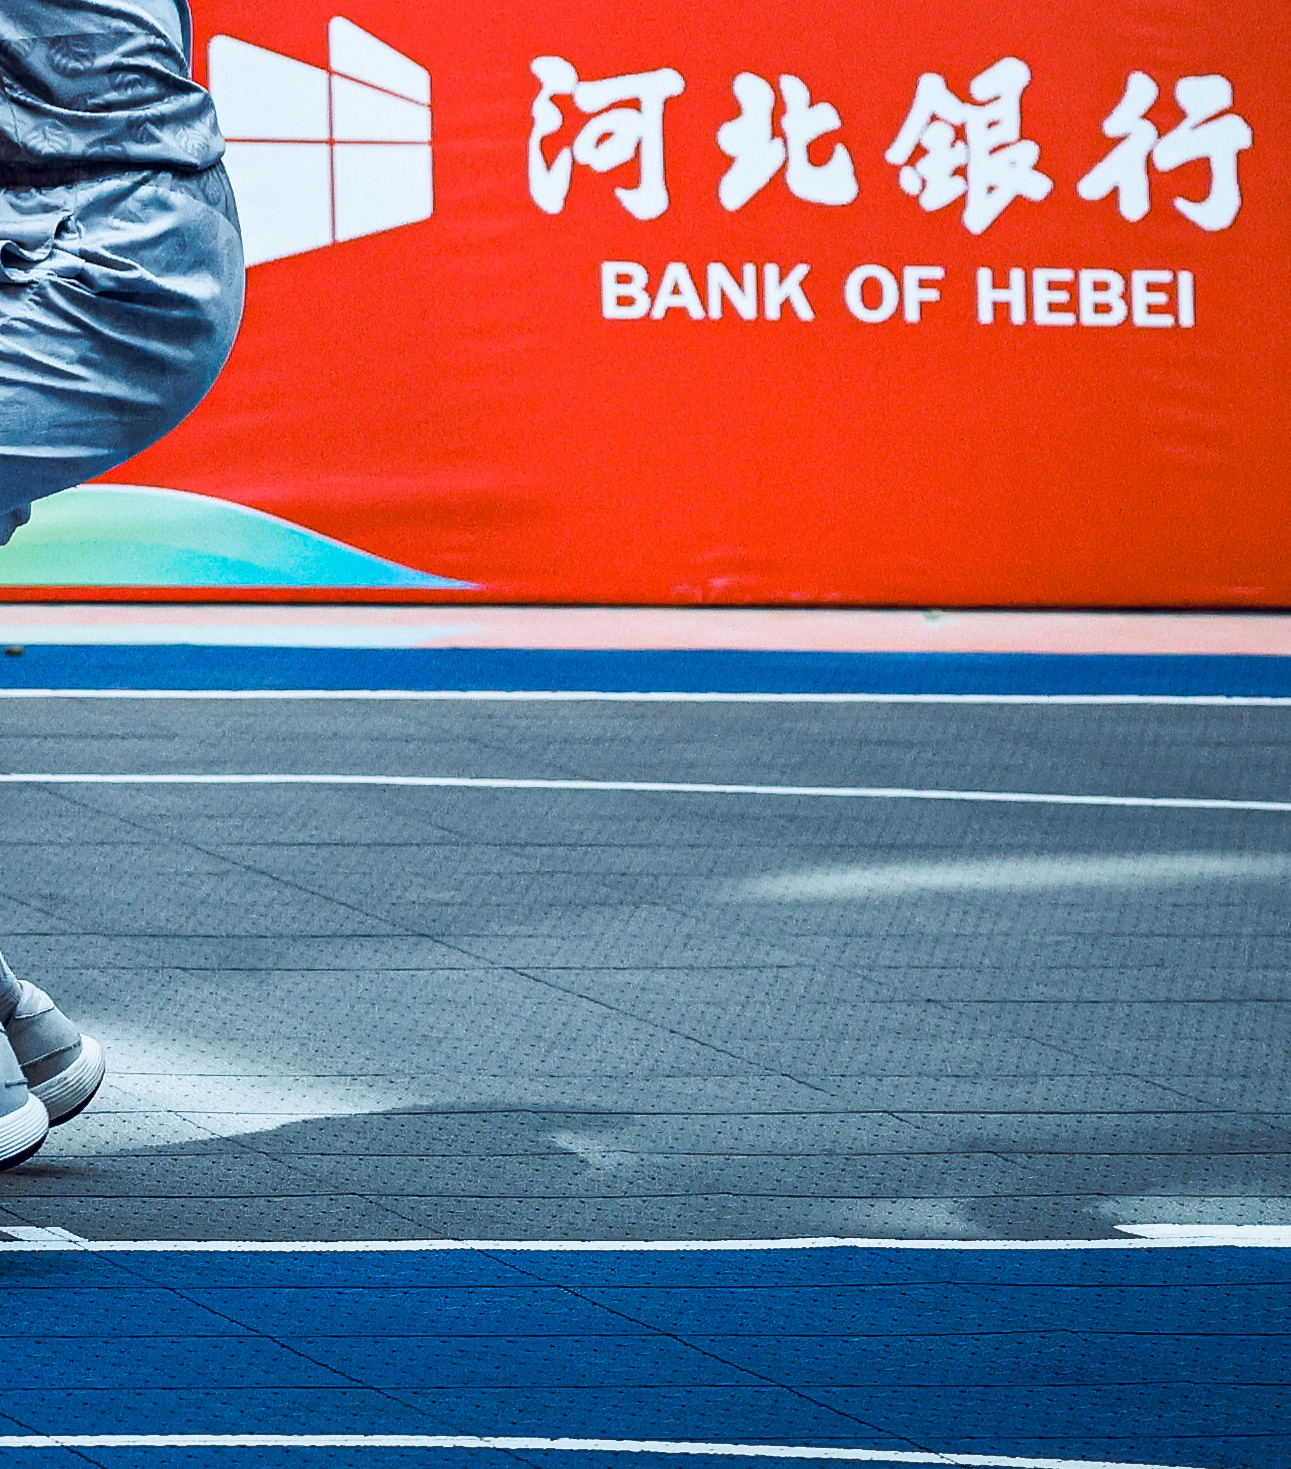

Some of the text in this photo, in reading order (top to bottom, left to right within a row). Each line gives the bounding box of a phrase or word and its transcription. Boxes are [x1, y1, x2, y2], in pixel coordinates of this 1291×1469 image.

[601, 261, 1197, 329] BANK OF HEBEI
